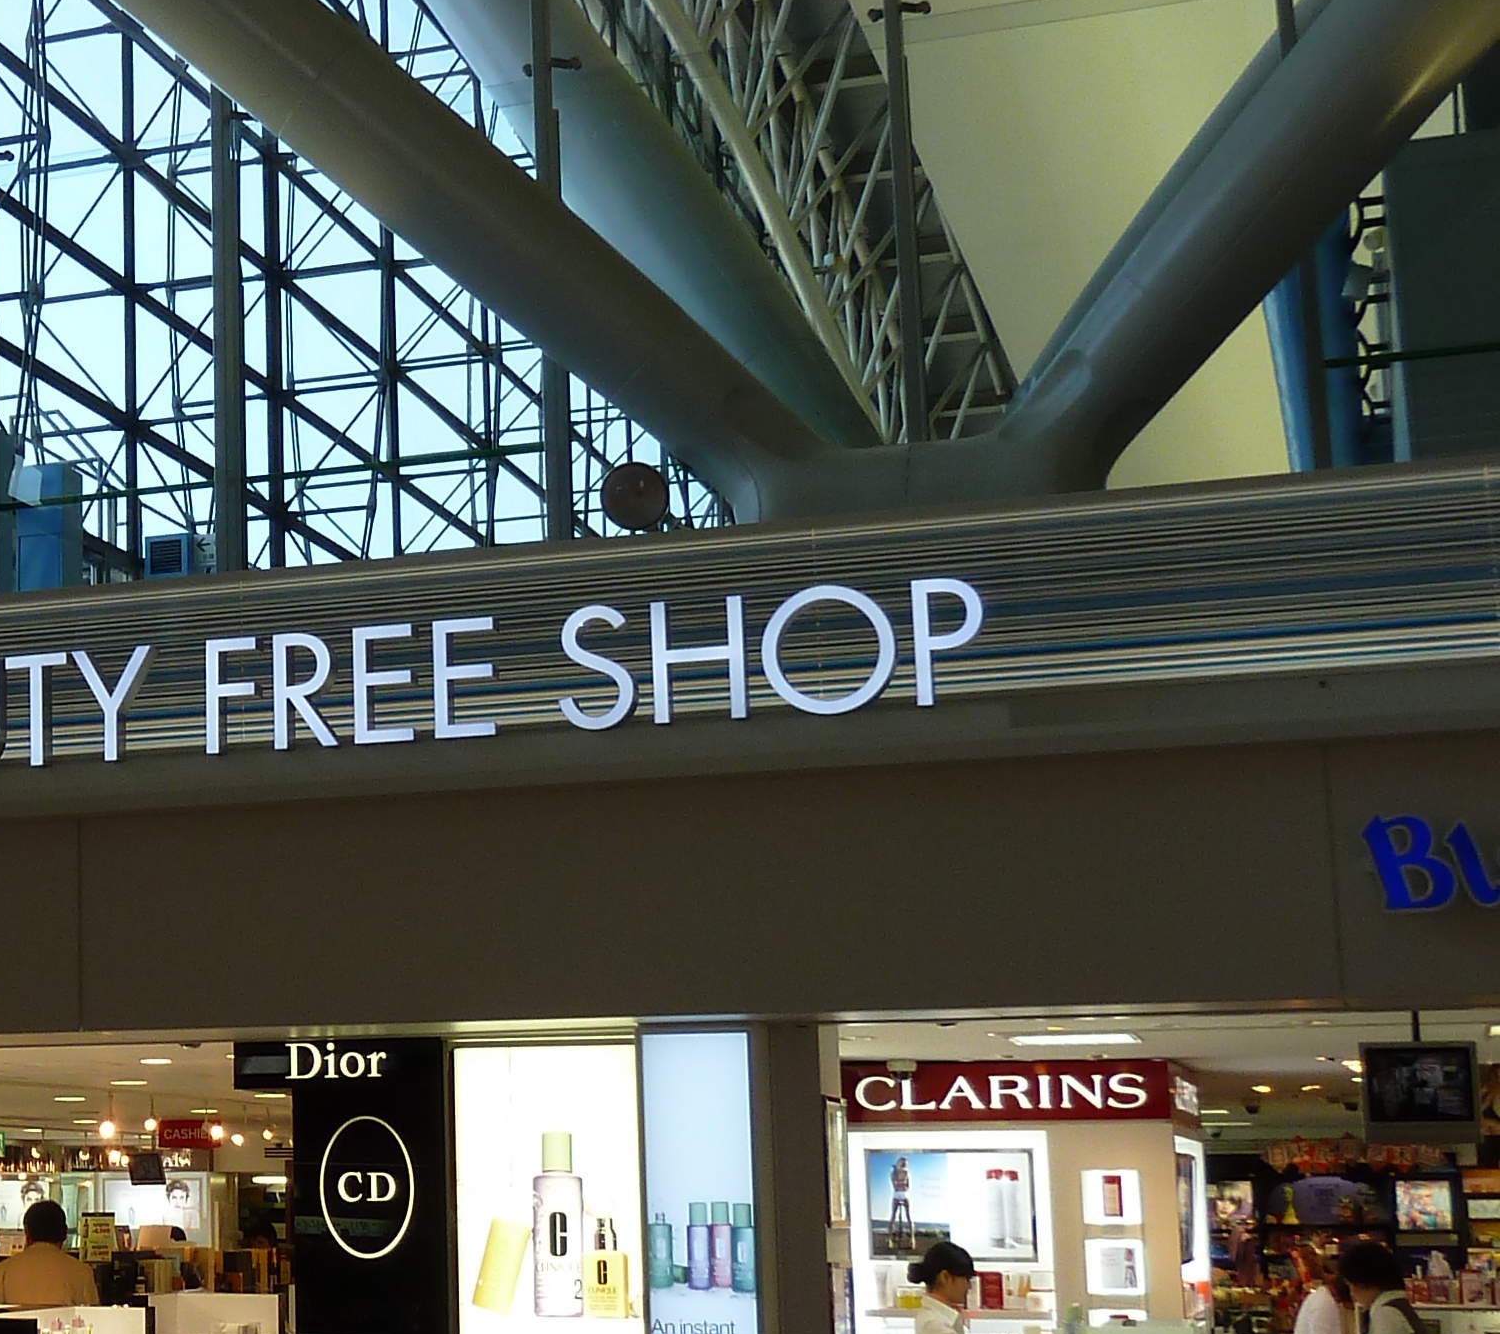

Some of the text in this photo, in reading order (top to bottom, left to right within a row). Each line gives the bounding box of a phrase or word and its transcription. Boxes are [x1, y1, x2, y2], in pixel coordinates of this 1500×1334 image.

[204, 615, 498, 756] FREE
[559, 577, 985, 732] SHOP
[285, 1042, 386, 1079] Dior
[855, 1072, 1148, 1112] CLARINS
[163, 1128, 213, 1141] CASHIE
[337, 1171, 397, 1203] CD
[651, 1318, 676, 1334] An
